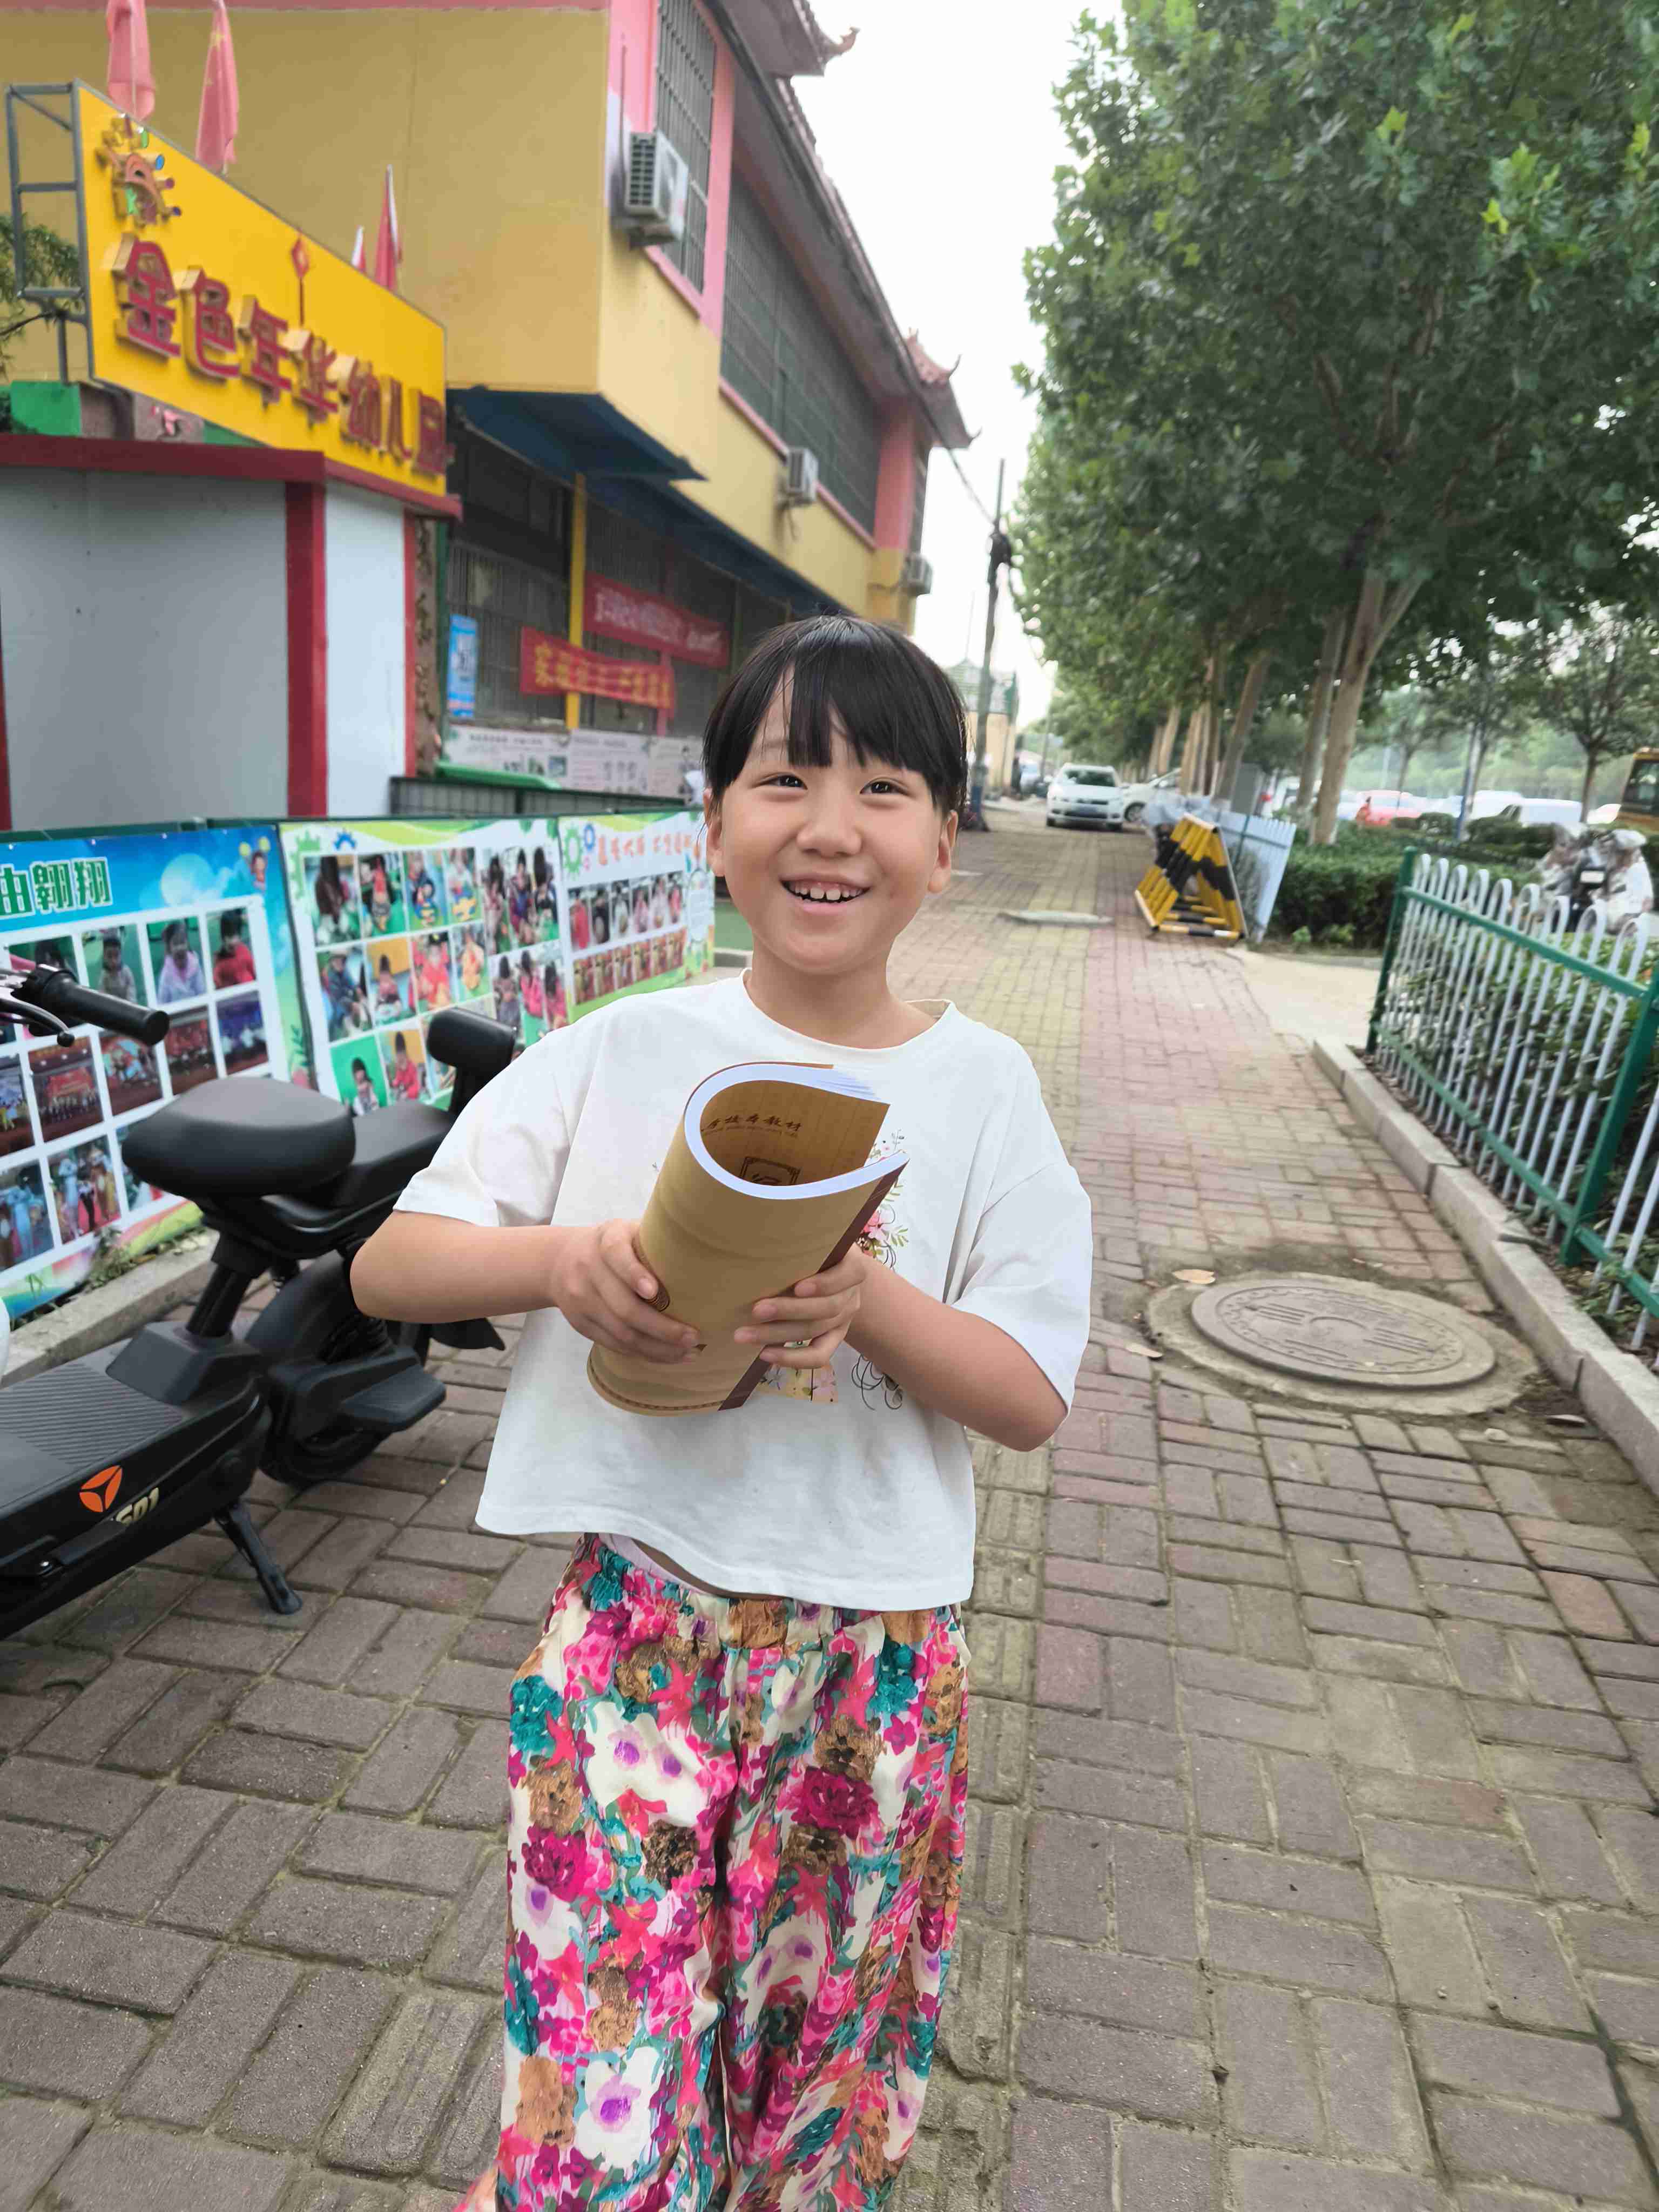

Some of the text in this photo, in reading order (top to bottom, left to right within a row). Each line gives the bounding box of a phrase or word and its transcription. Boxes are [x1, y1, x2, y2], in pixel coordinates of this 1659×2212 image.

[111, 233, 446, 477] 金色年华幼儿园
